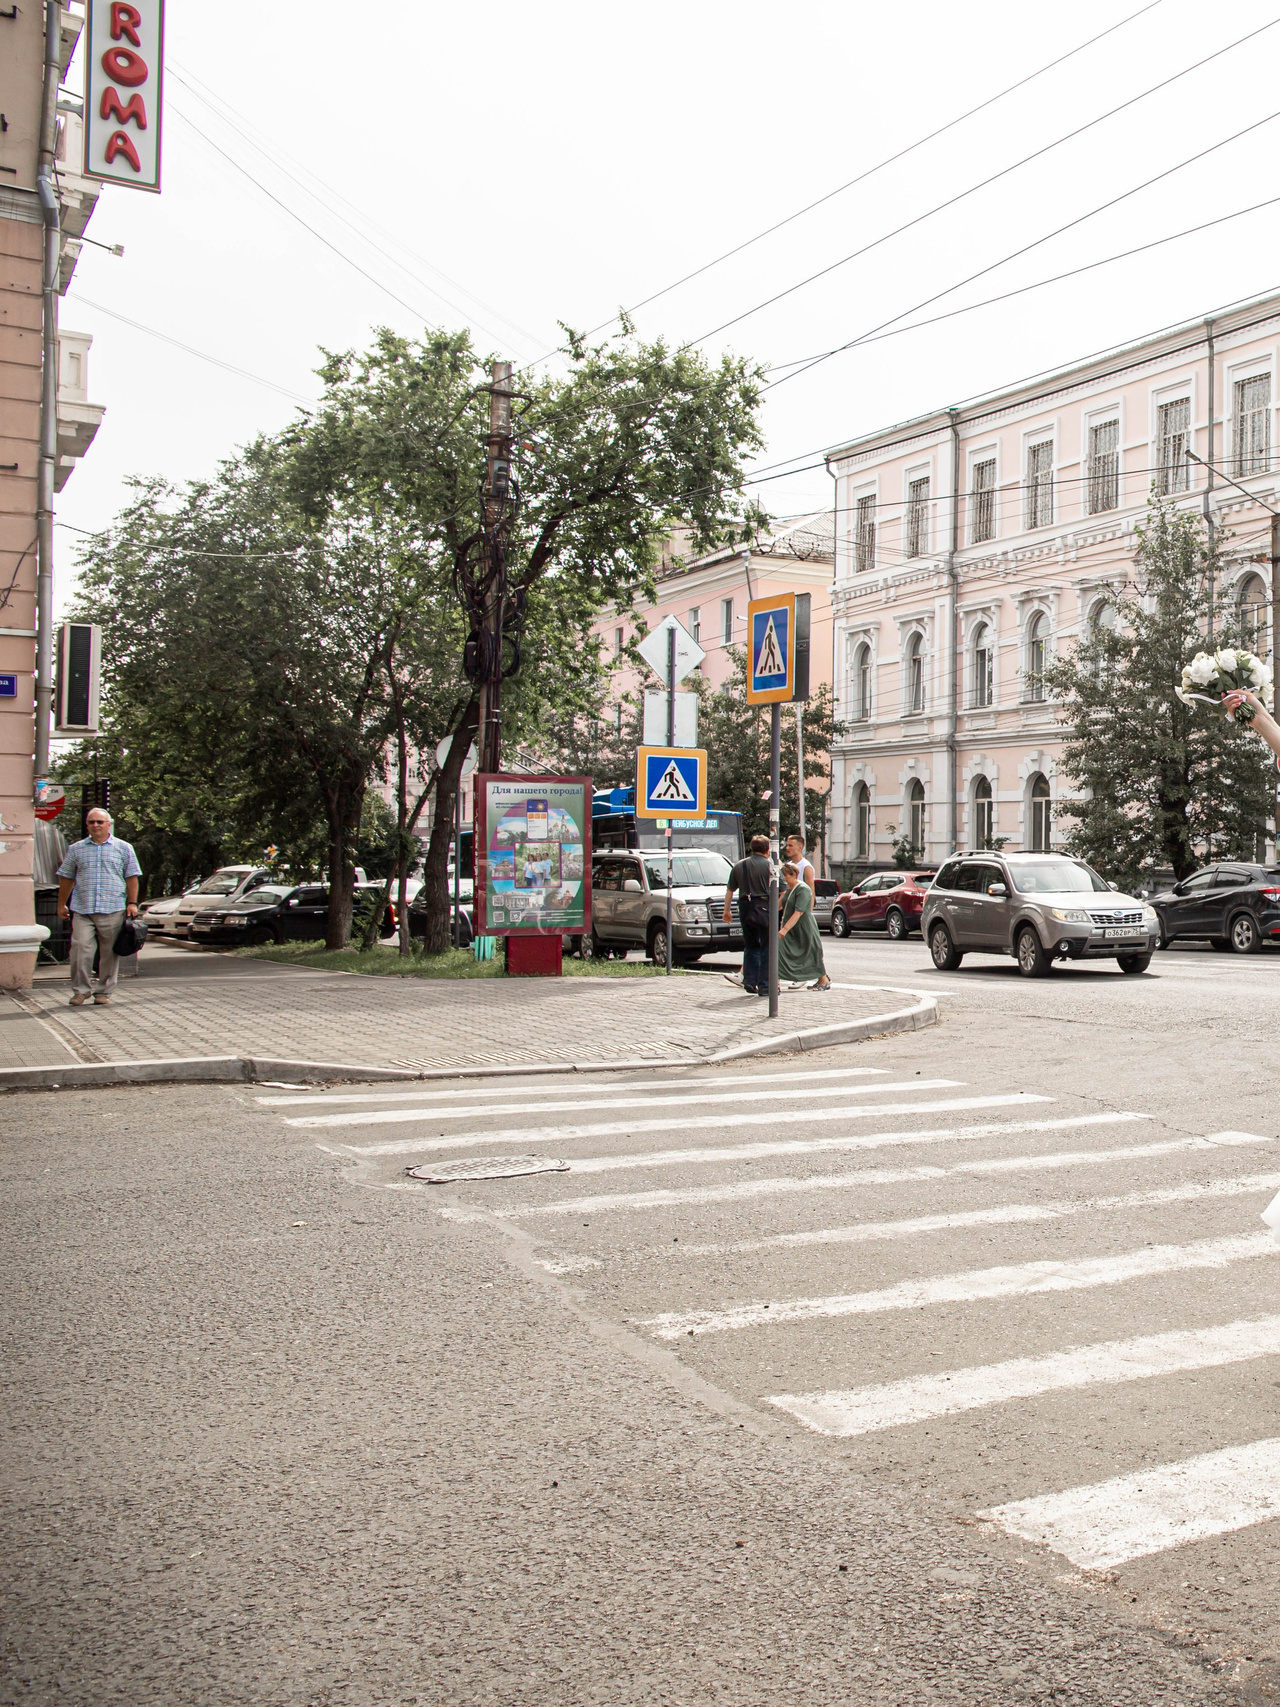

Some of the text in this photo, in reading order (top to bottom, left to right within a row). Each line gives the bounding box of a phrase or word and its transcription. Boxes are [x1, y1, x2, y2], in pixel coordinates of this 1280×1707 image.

[100, 1, 149, 173] ROMA
[492, 786, 583, 796] Для нашего города!
